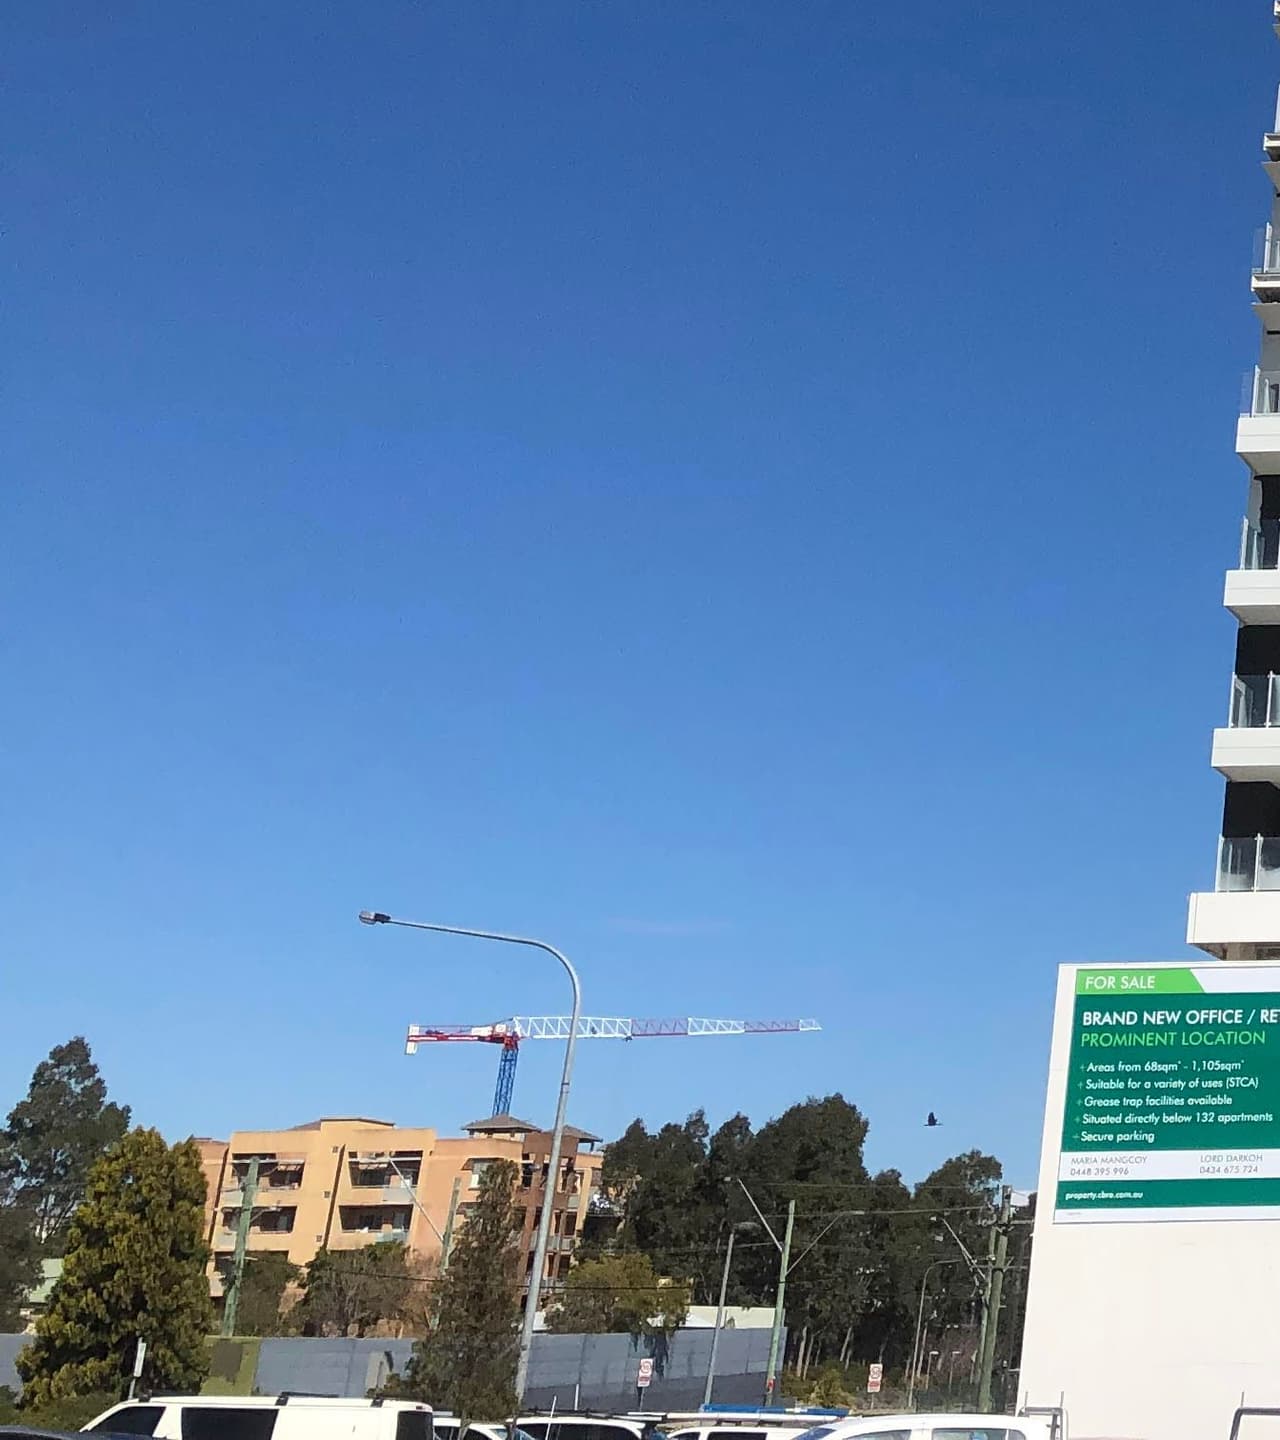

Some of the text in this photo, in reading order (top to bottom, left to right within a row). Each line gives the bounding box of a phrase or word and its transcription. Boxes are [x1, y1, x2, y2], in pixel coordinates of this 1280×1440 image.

[1085, 975, 1156, 990] FOR SALE
[1082, 1011, 1138, 1026] BRAND
[1142, 1010, 1182, 1025] NEW
[1185, 1009, 1244, 1025] OFFICE
[1080, 1030, 1266, 1047] PROMINENT LOCATION
[1086, 1062, 1115, 1073] Areas
[1118, 1061, 1142, 1072] from
[1085, 1076, 1259, 1091] Suitable for a variety of uses (STCA)
[1083, 1093, 1233, 1108] Grease trap facilities available
[1082, 1111, 1273, 1125] Situated directly below 132 apartments
[1080, 1130, 1155, 1143] Secure parking
[1071, 1156, 1098, 1165] MARIA
[1200, 1155, 1224, 1163] LORD
[1070, 1168, 1092, 1176] 0448
[1199, 1166, 1221, 1174] 0434
[1065, 1190, 1144, 1200] property.cbre.com.au
